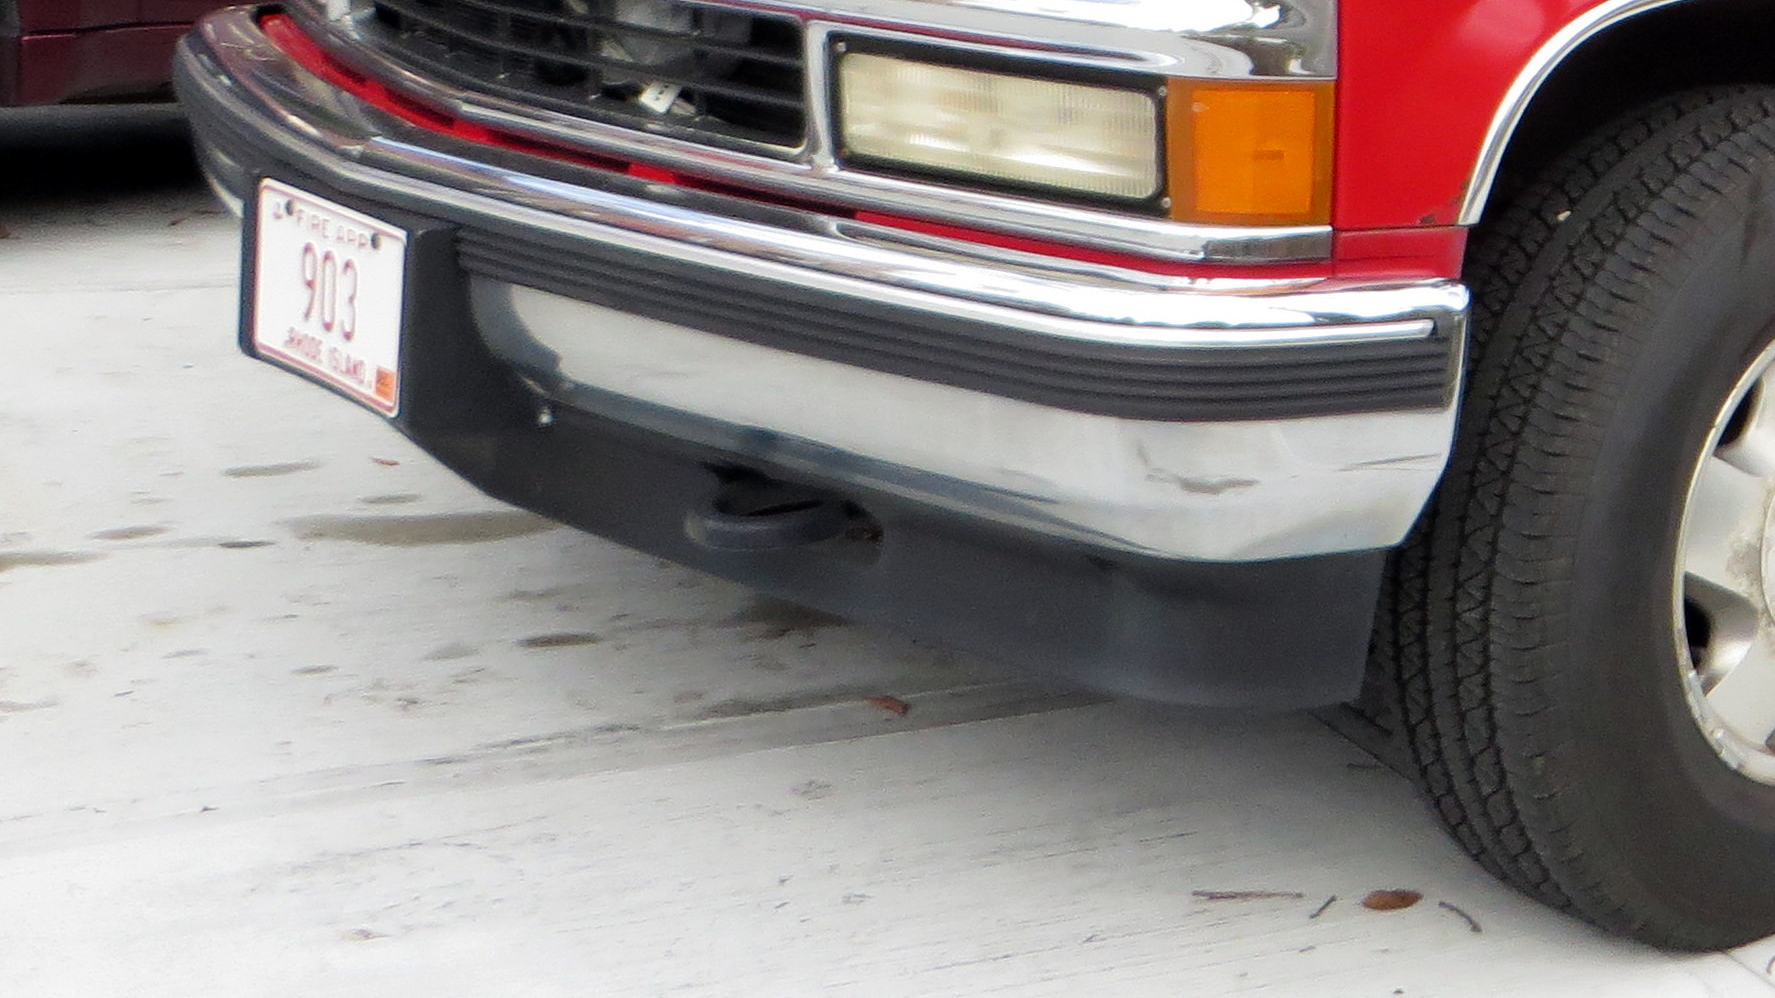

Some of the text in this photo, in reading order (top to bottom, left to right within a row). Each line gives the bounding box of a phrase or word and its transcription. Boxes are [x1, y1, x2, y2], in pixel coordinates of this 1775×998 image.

[297, 208, 370, 249] FIRE APP
[302, 241, 359, 341] 903
